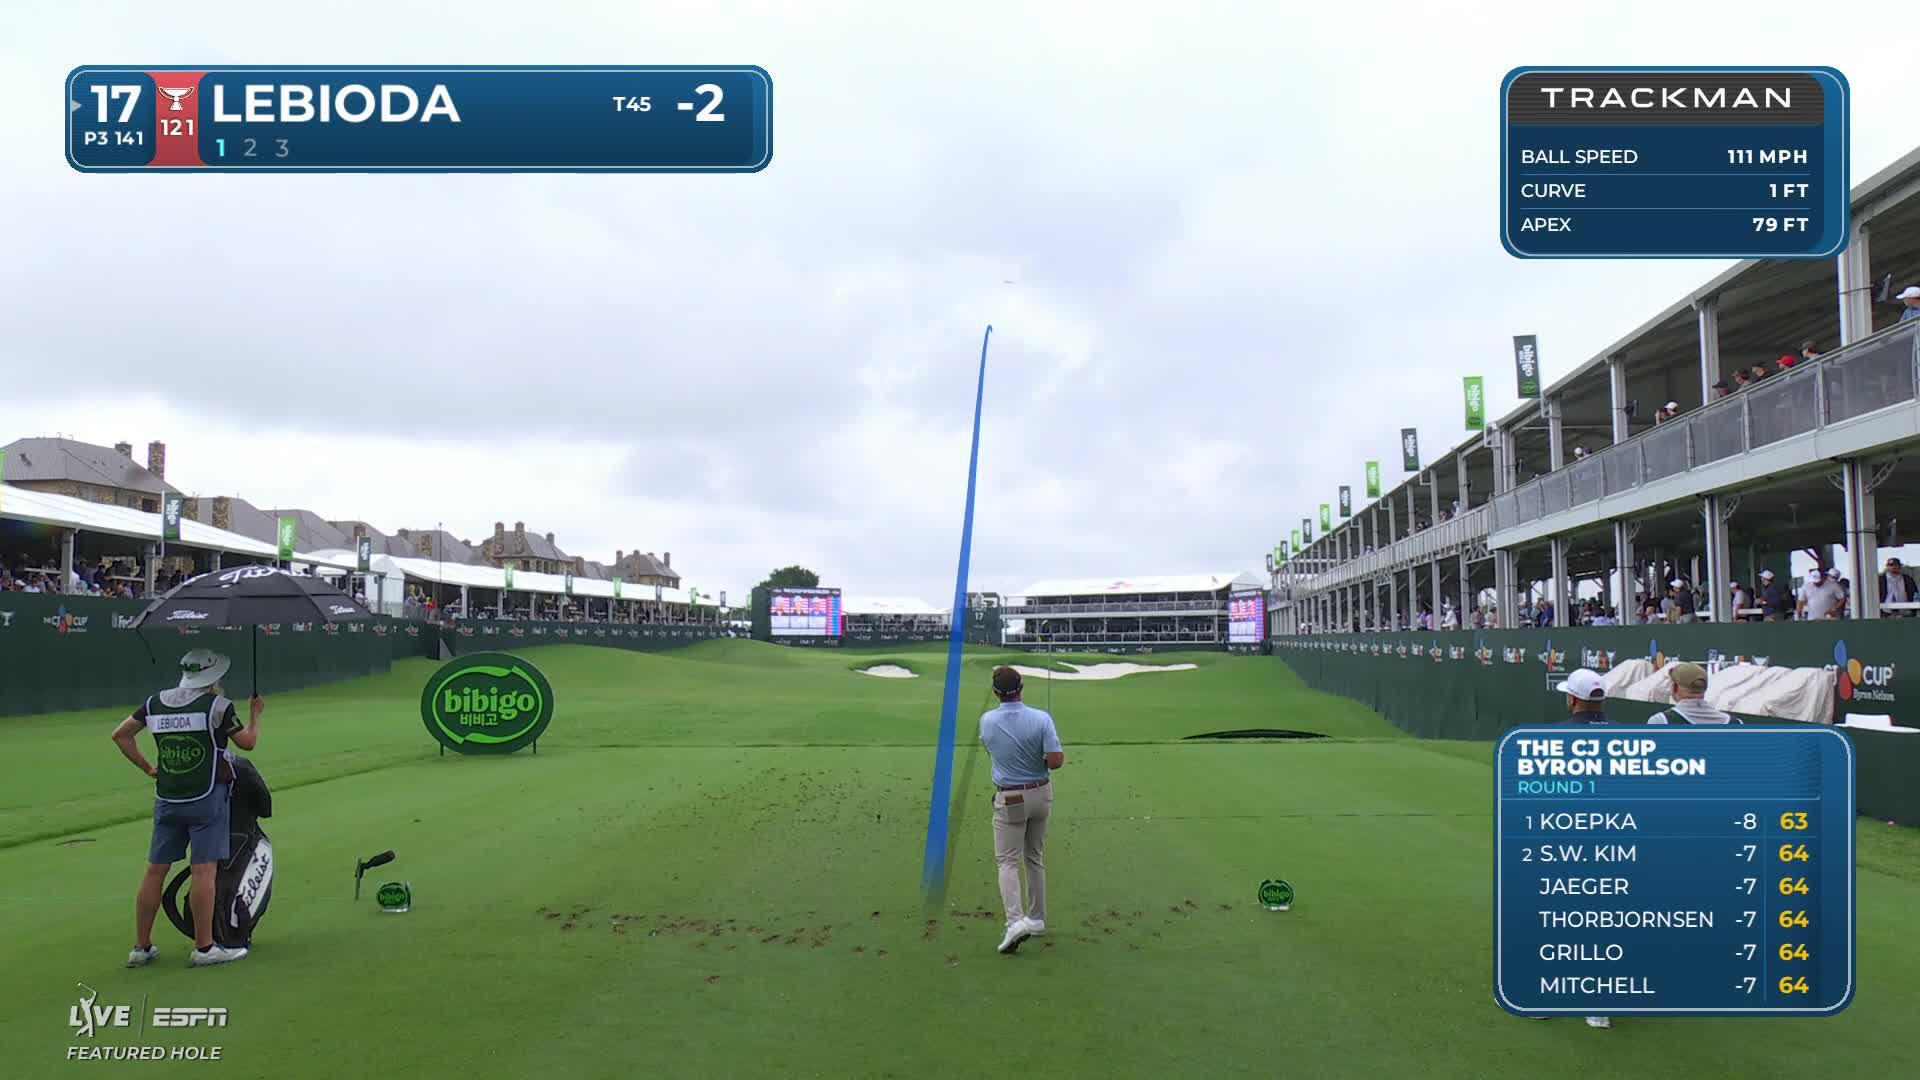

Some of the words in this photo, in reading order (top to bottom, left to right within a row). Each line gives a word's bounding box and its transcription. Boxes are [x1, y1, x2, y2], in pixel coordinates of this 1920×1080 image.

[1862, 665, 1893, 687] CUP
[444, 687, 535, 720] bibigo
[157, 717, 192, 729] LEBIODA
[460, 713, 498, 727] 비비고
